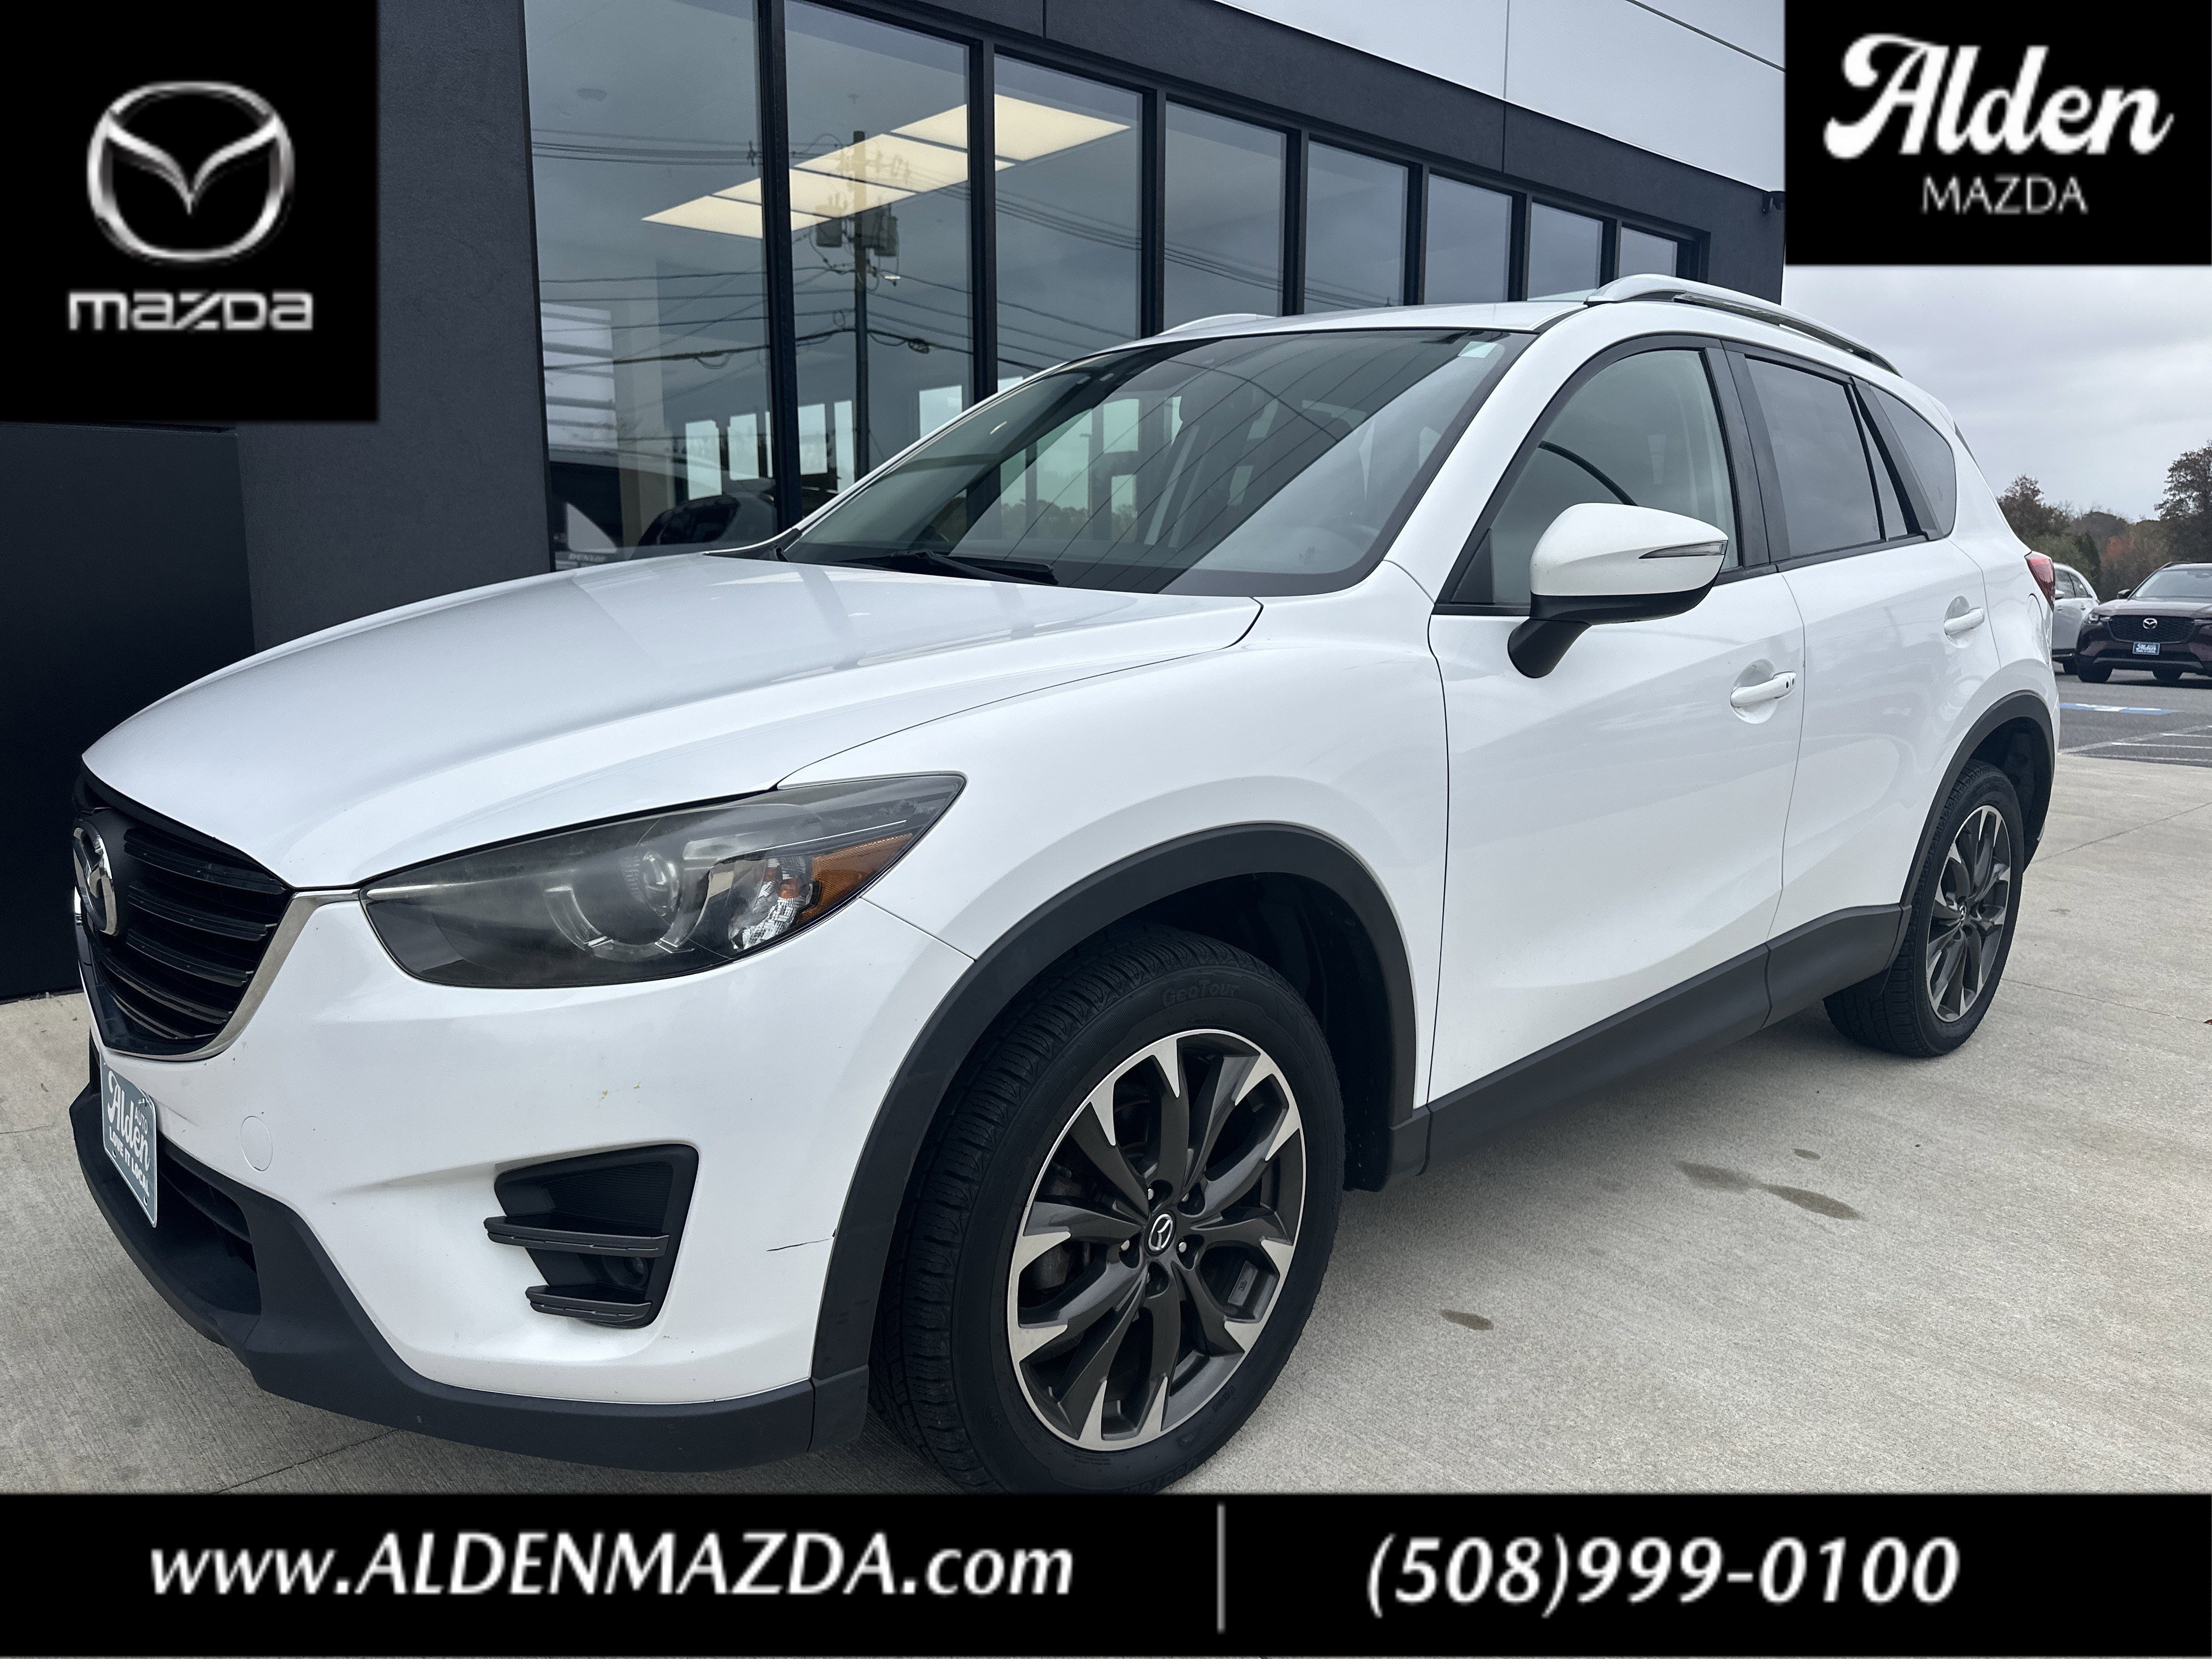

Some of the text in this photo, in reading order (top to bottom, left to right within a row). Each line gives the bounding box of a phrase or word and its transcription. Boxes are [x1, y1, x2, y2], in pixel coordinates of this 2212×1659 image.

[108, 1070, 150, 1171] Alden
[134, 1107, 148, 1135] AUTO
[109, 1125, 150, 1197] LOVE IT LOCAL
